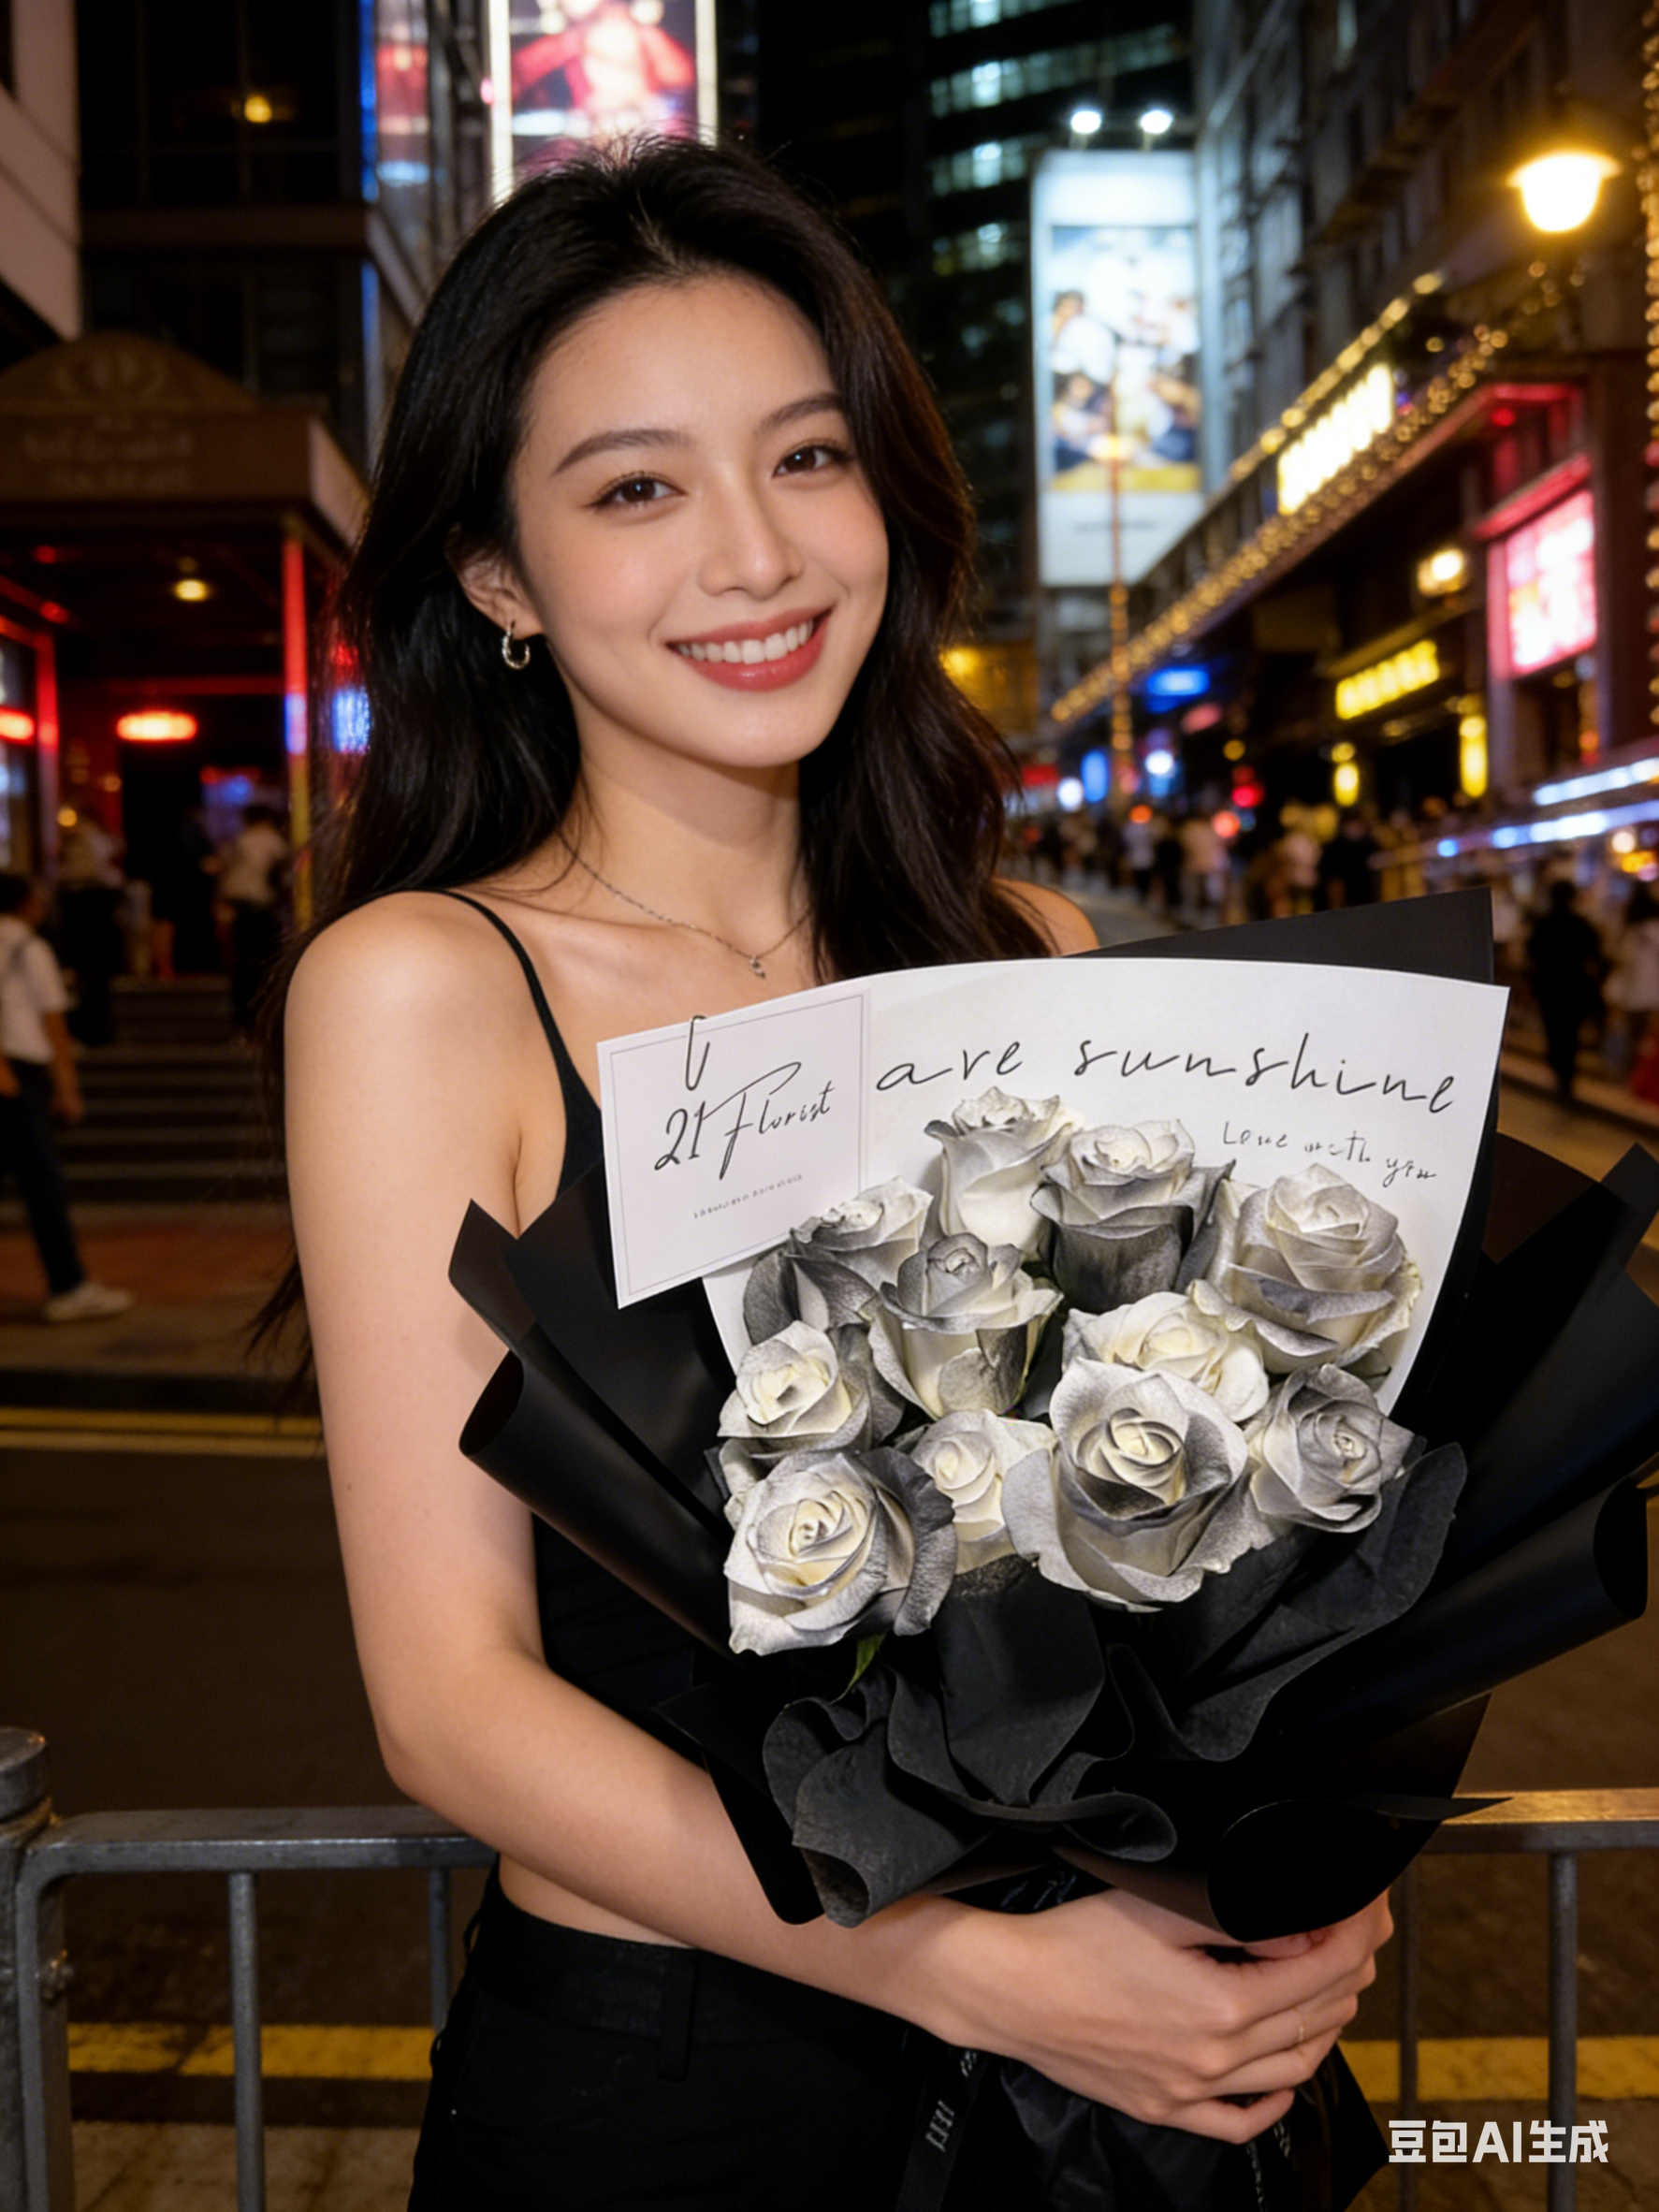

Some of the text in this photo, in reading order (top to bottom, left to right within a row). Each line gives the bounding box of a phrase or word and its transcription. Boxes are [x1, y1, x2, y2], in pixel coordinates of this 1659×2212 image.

[876, 1032, 1456, 1114] are sunshine
[654, 1100, 706, 1171] 21
